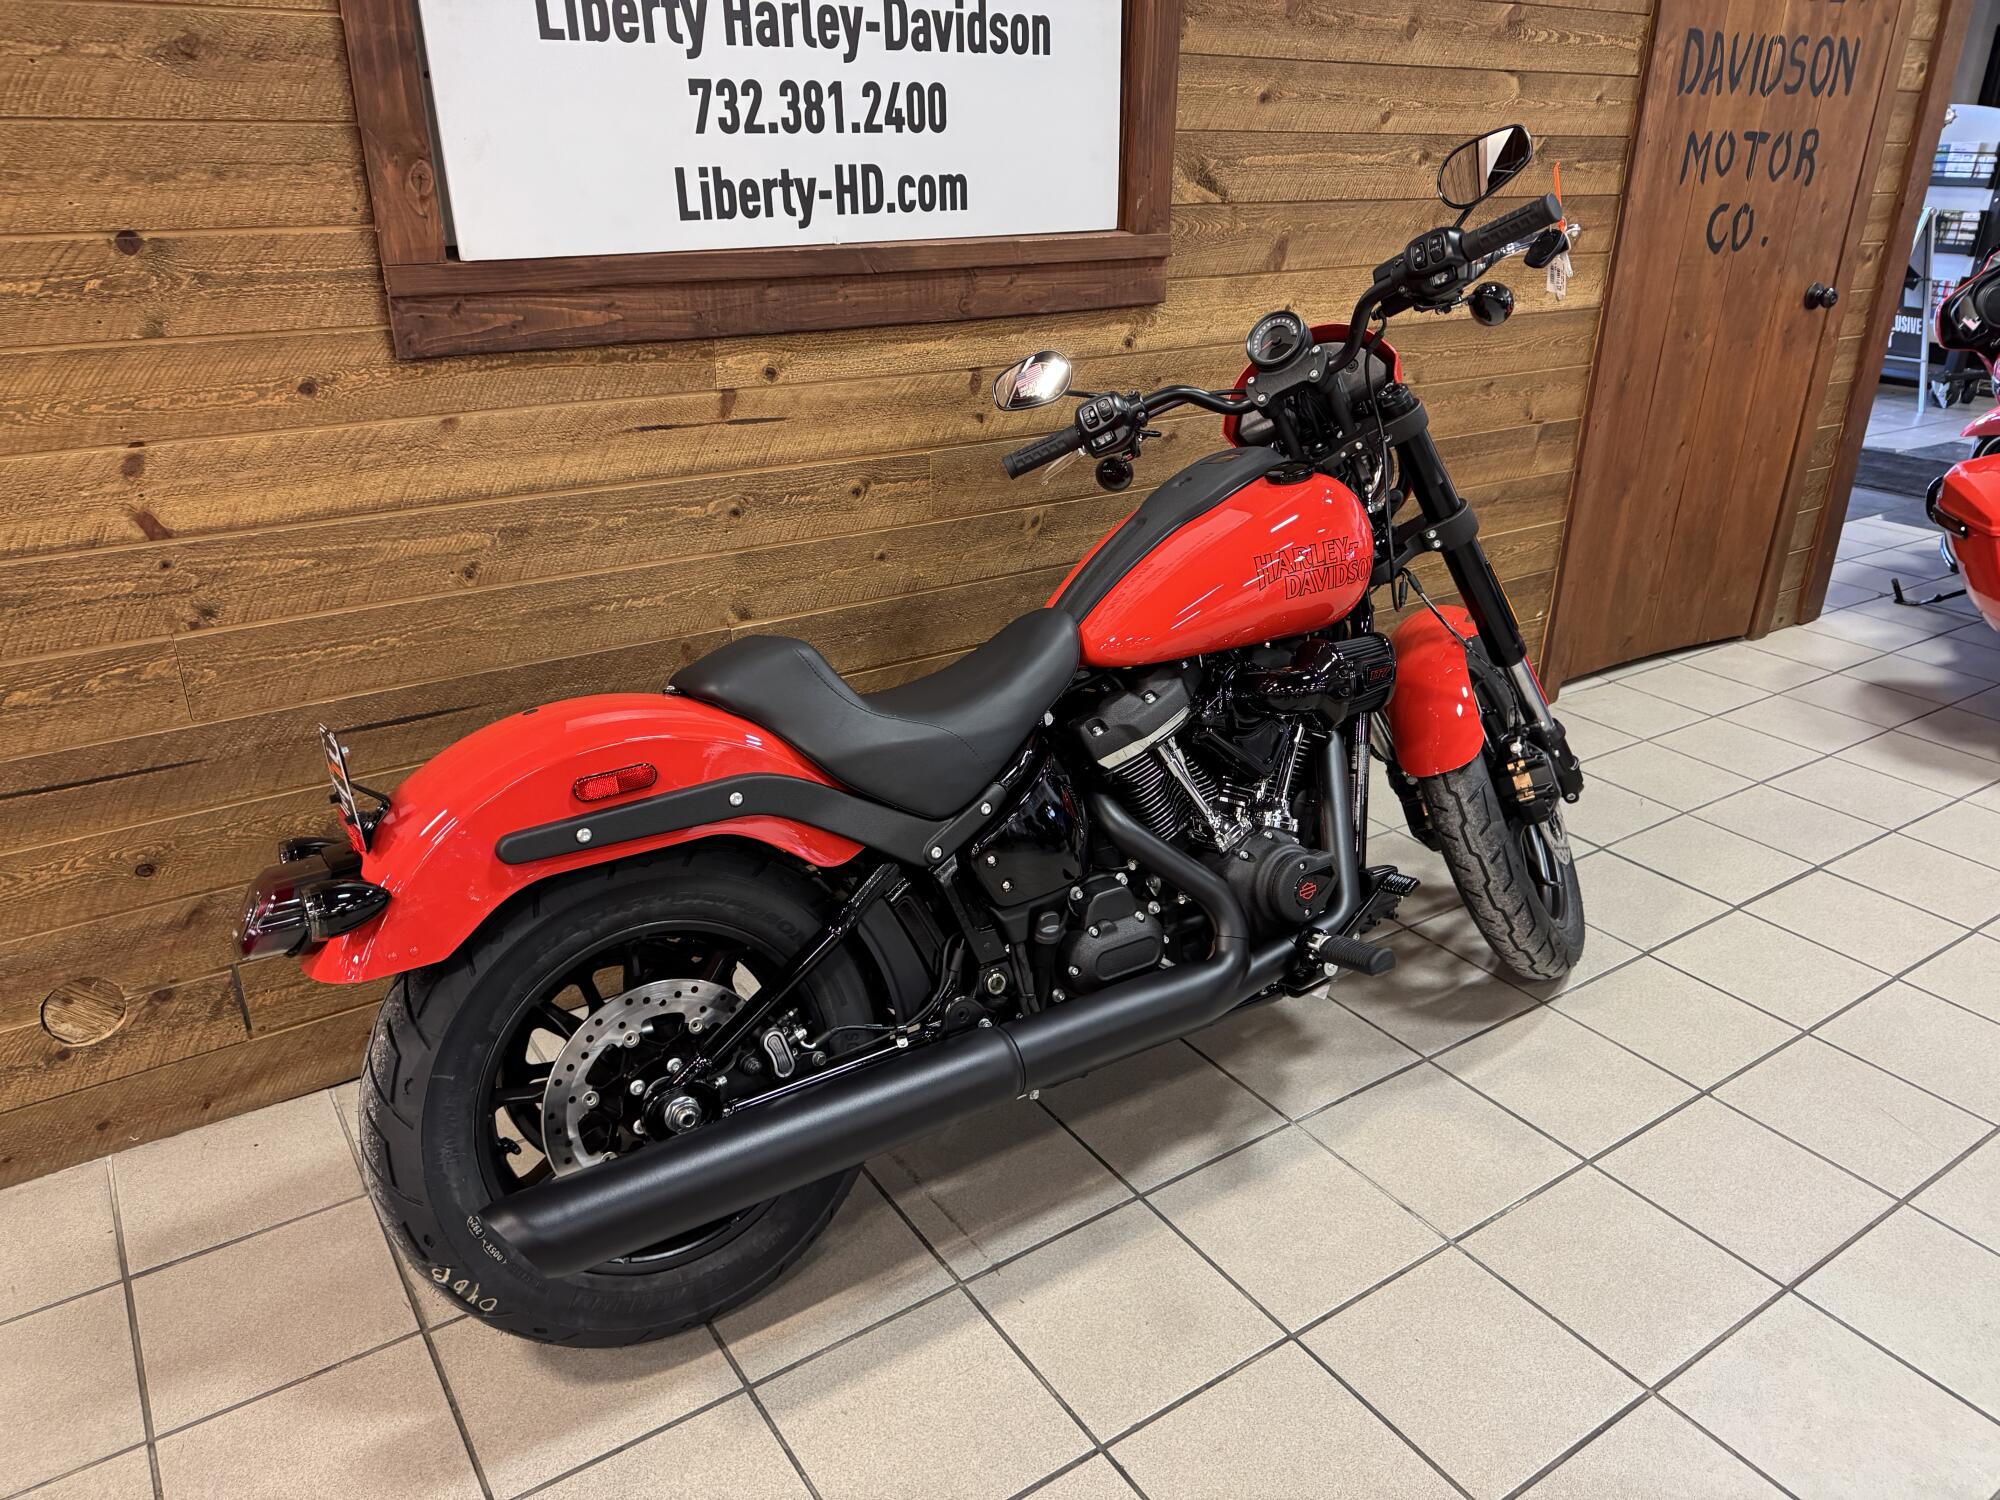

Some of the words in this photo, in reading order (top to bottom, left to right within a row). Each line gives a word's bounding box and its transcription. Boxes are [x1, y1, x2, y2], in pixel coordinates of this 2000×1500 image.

[535, 0, 708, 60] Liberty
[722, 0, 1052, 64] Harley-Davidson
[1676, 27, 1862, 98] DAVIDSON
[687, 78, 948, 135] 732.381.2400
[1679, 127, 1820, 187] MOTOR
[674, 163, 969, 230] Liberty-HD.com
[1706, 202, 1769, 255] CO.
[1284, 556, 1371, 600] DAVIDSO
